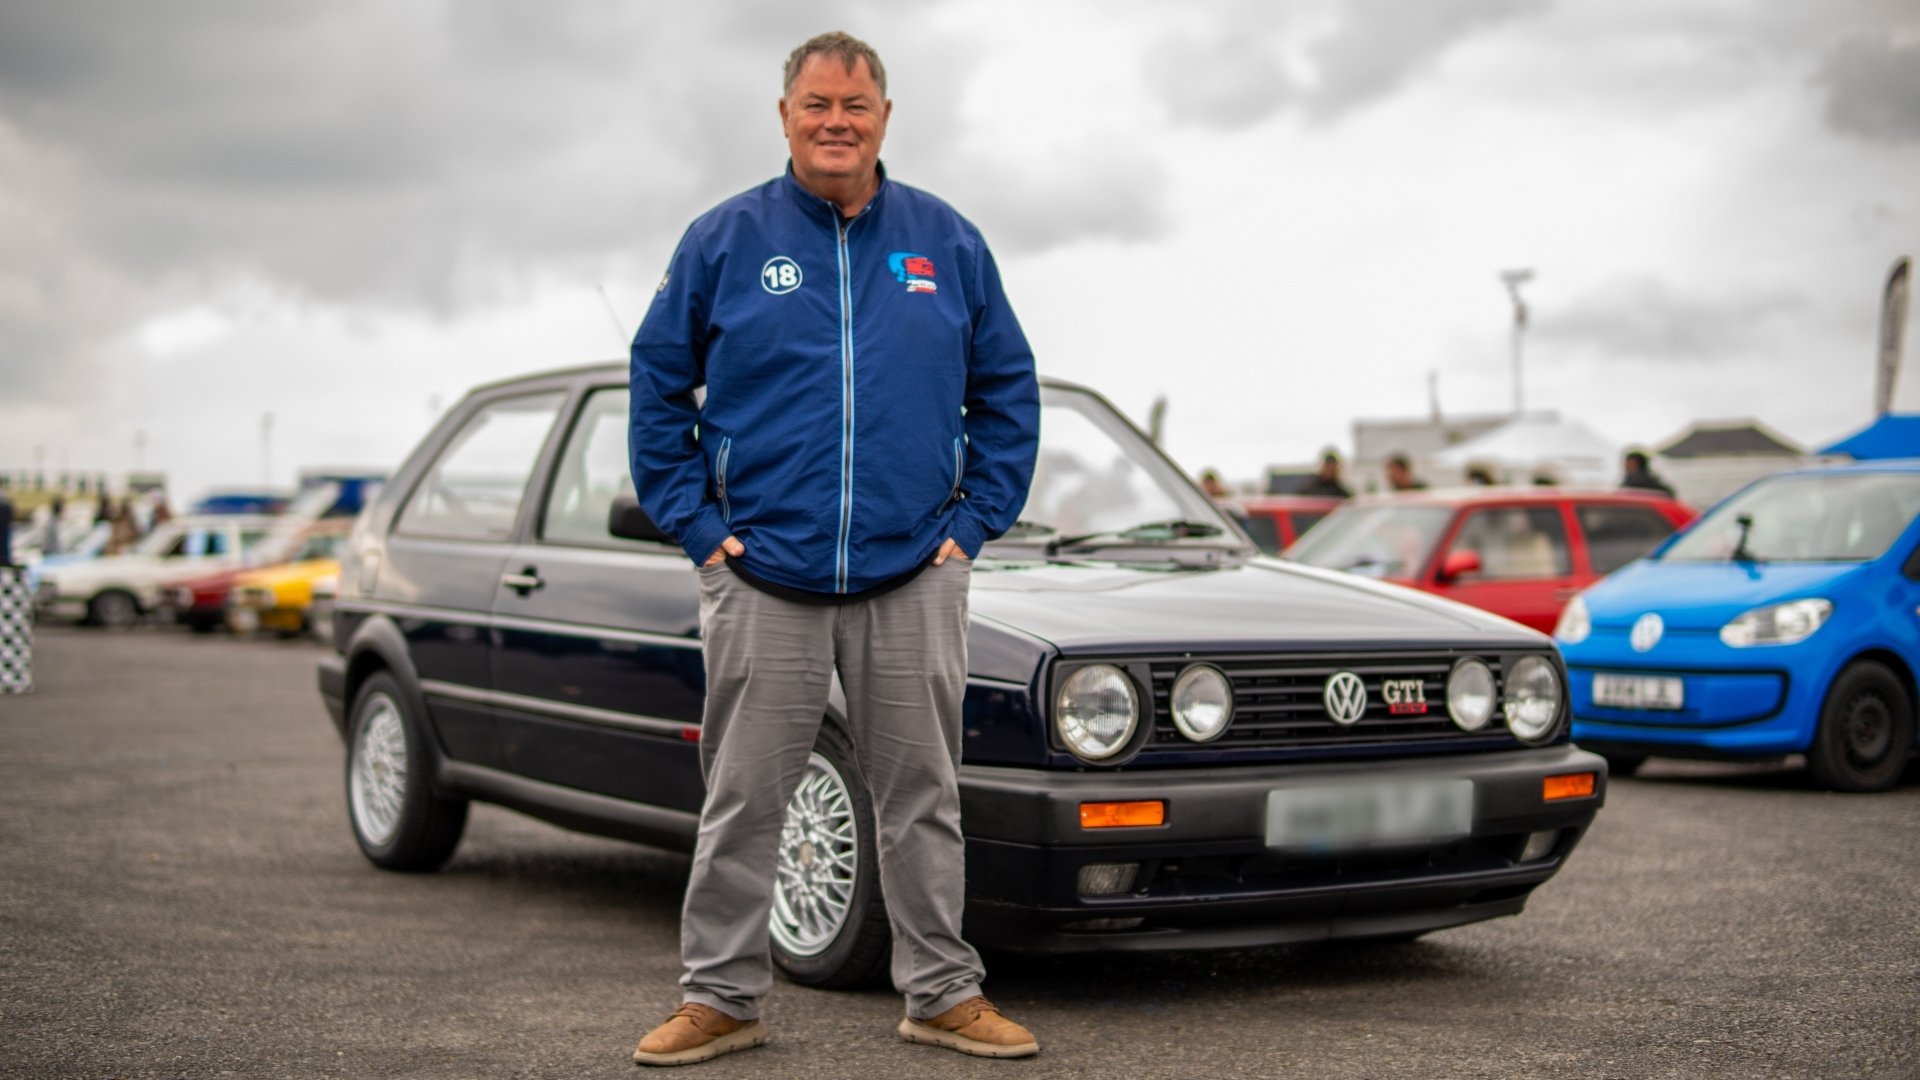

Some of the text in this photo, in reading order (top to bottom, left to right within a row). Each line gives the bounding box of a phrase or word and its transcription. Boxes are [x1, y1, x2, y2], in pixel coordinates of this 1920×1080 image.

[764, 263, 797, 289] 18
[1328, 674, 1365, 722] VW
[1383, 679, 1426, 704] GTI
